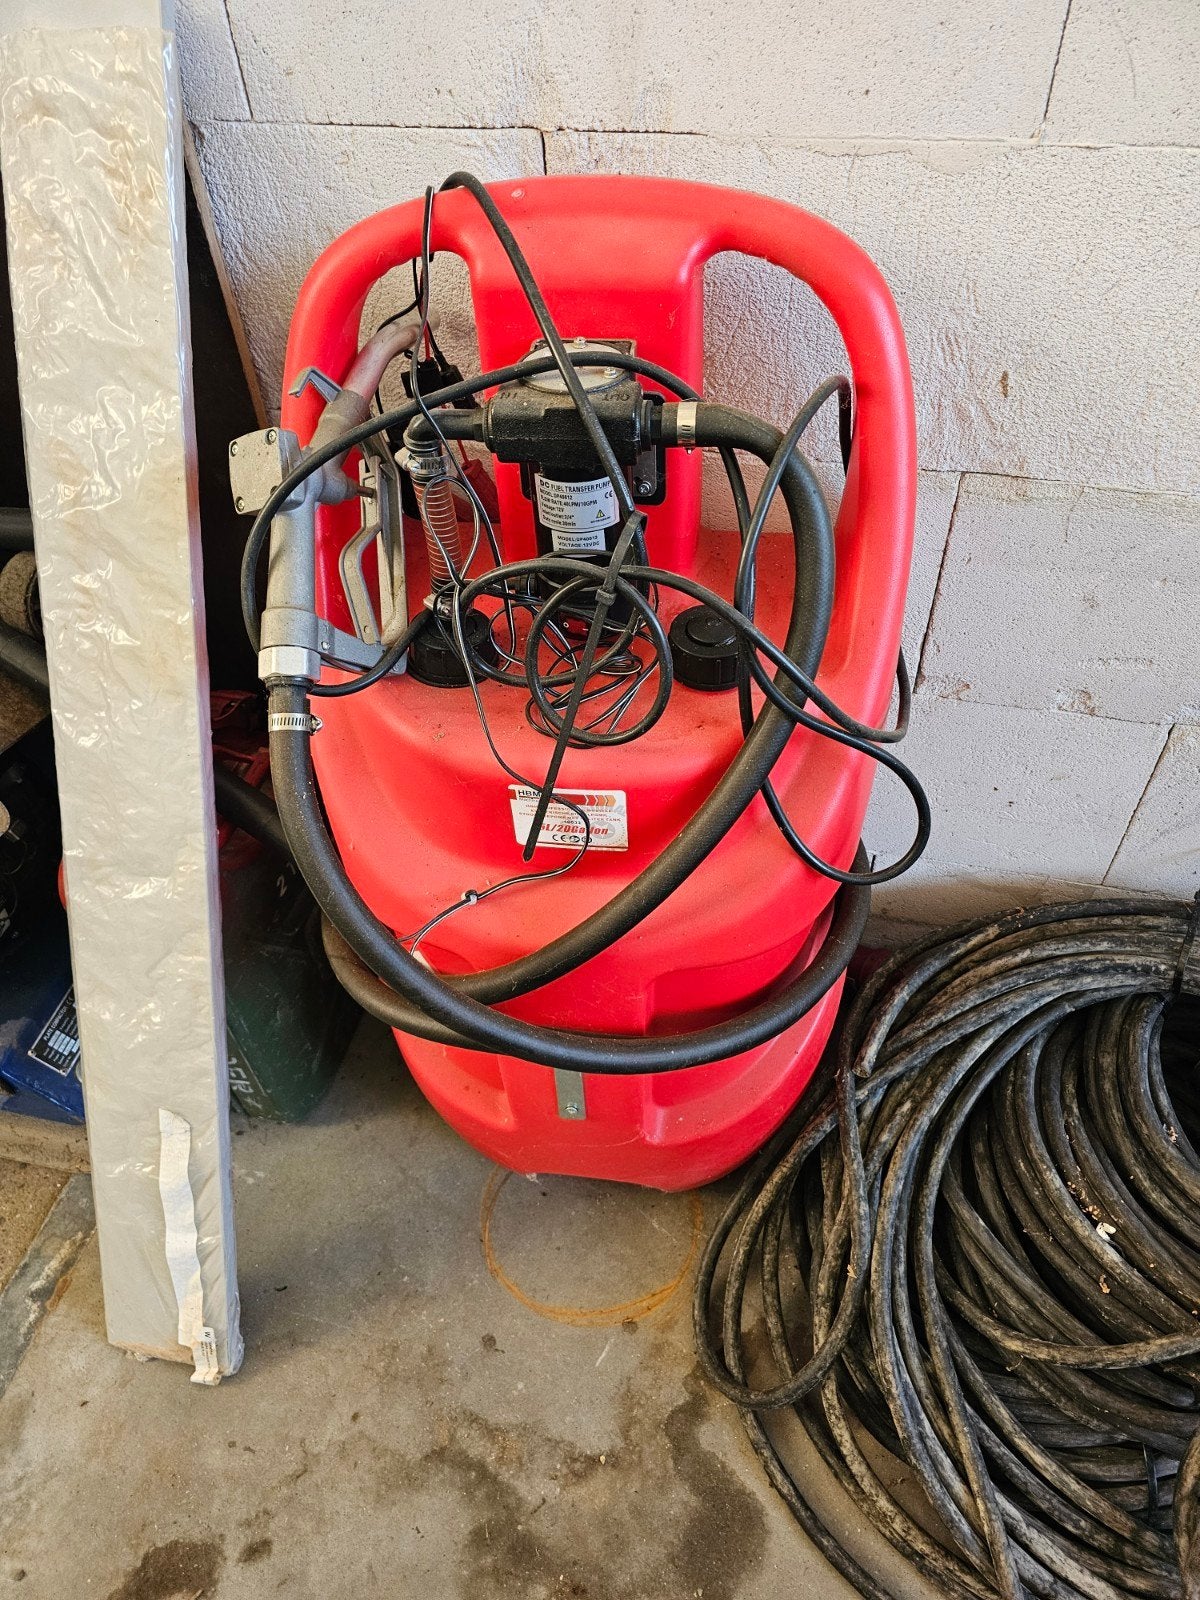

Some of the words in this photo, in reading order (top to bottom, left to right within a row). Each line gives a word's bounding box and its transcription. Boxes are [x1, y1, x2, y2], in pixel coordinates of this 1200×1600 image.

[540, 479, 550, 488] DC
[551, 484, 564, 492] FUEL
[565, 483, 595, 493] TRANSFER
